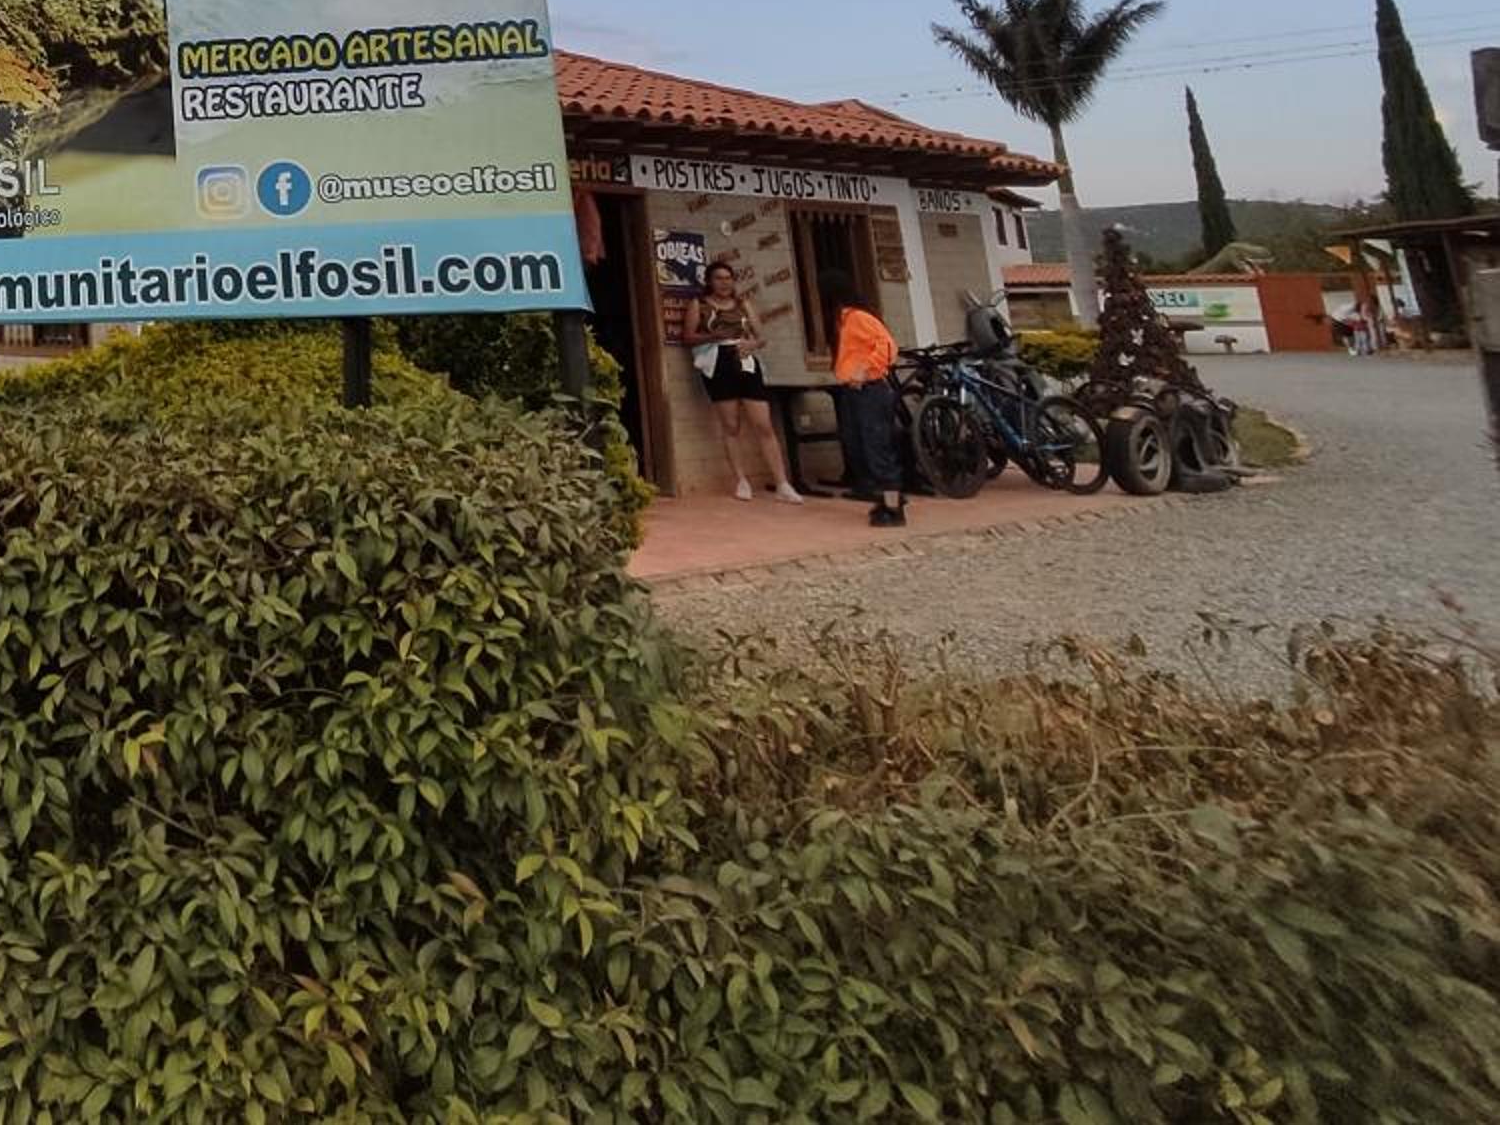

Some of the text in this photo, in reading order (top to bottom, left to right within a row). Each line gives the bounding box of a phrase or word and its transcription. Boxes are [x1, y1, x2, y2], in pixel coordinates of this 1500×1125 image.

[179, 19, 549, 78] MERCADO ARTESANAL
[182, 74, 424, 120] RESTAURANTE
[318, 164, 557, 203] @museoelfosil
[653, 159, 870, 202] POSTRES JUGOS TINTO
[1152, 292, 1190, 307] SEO
